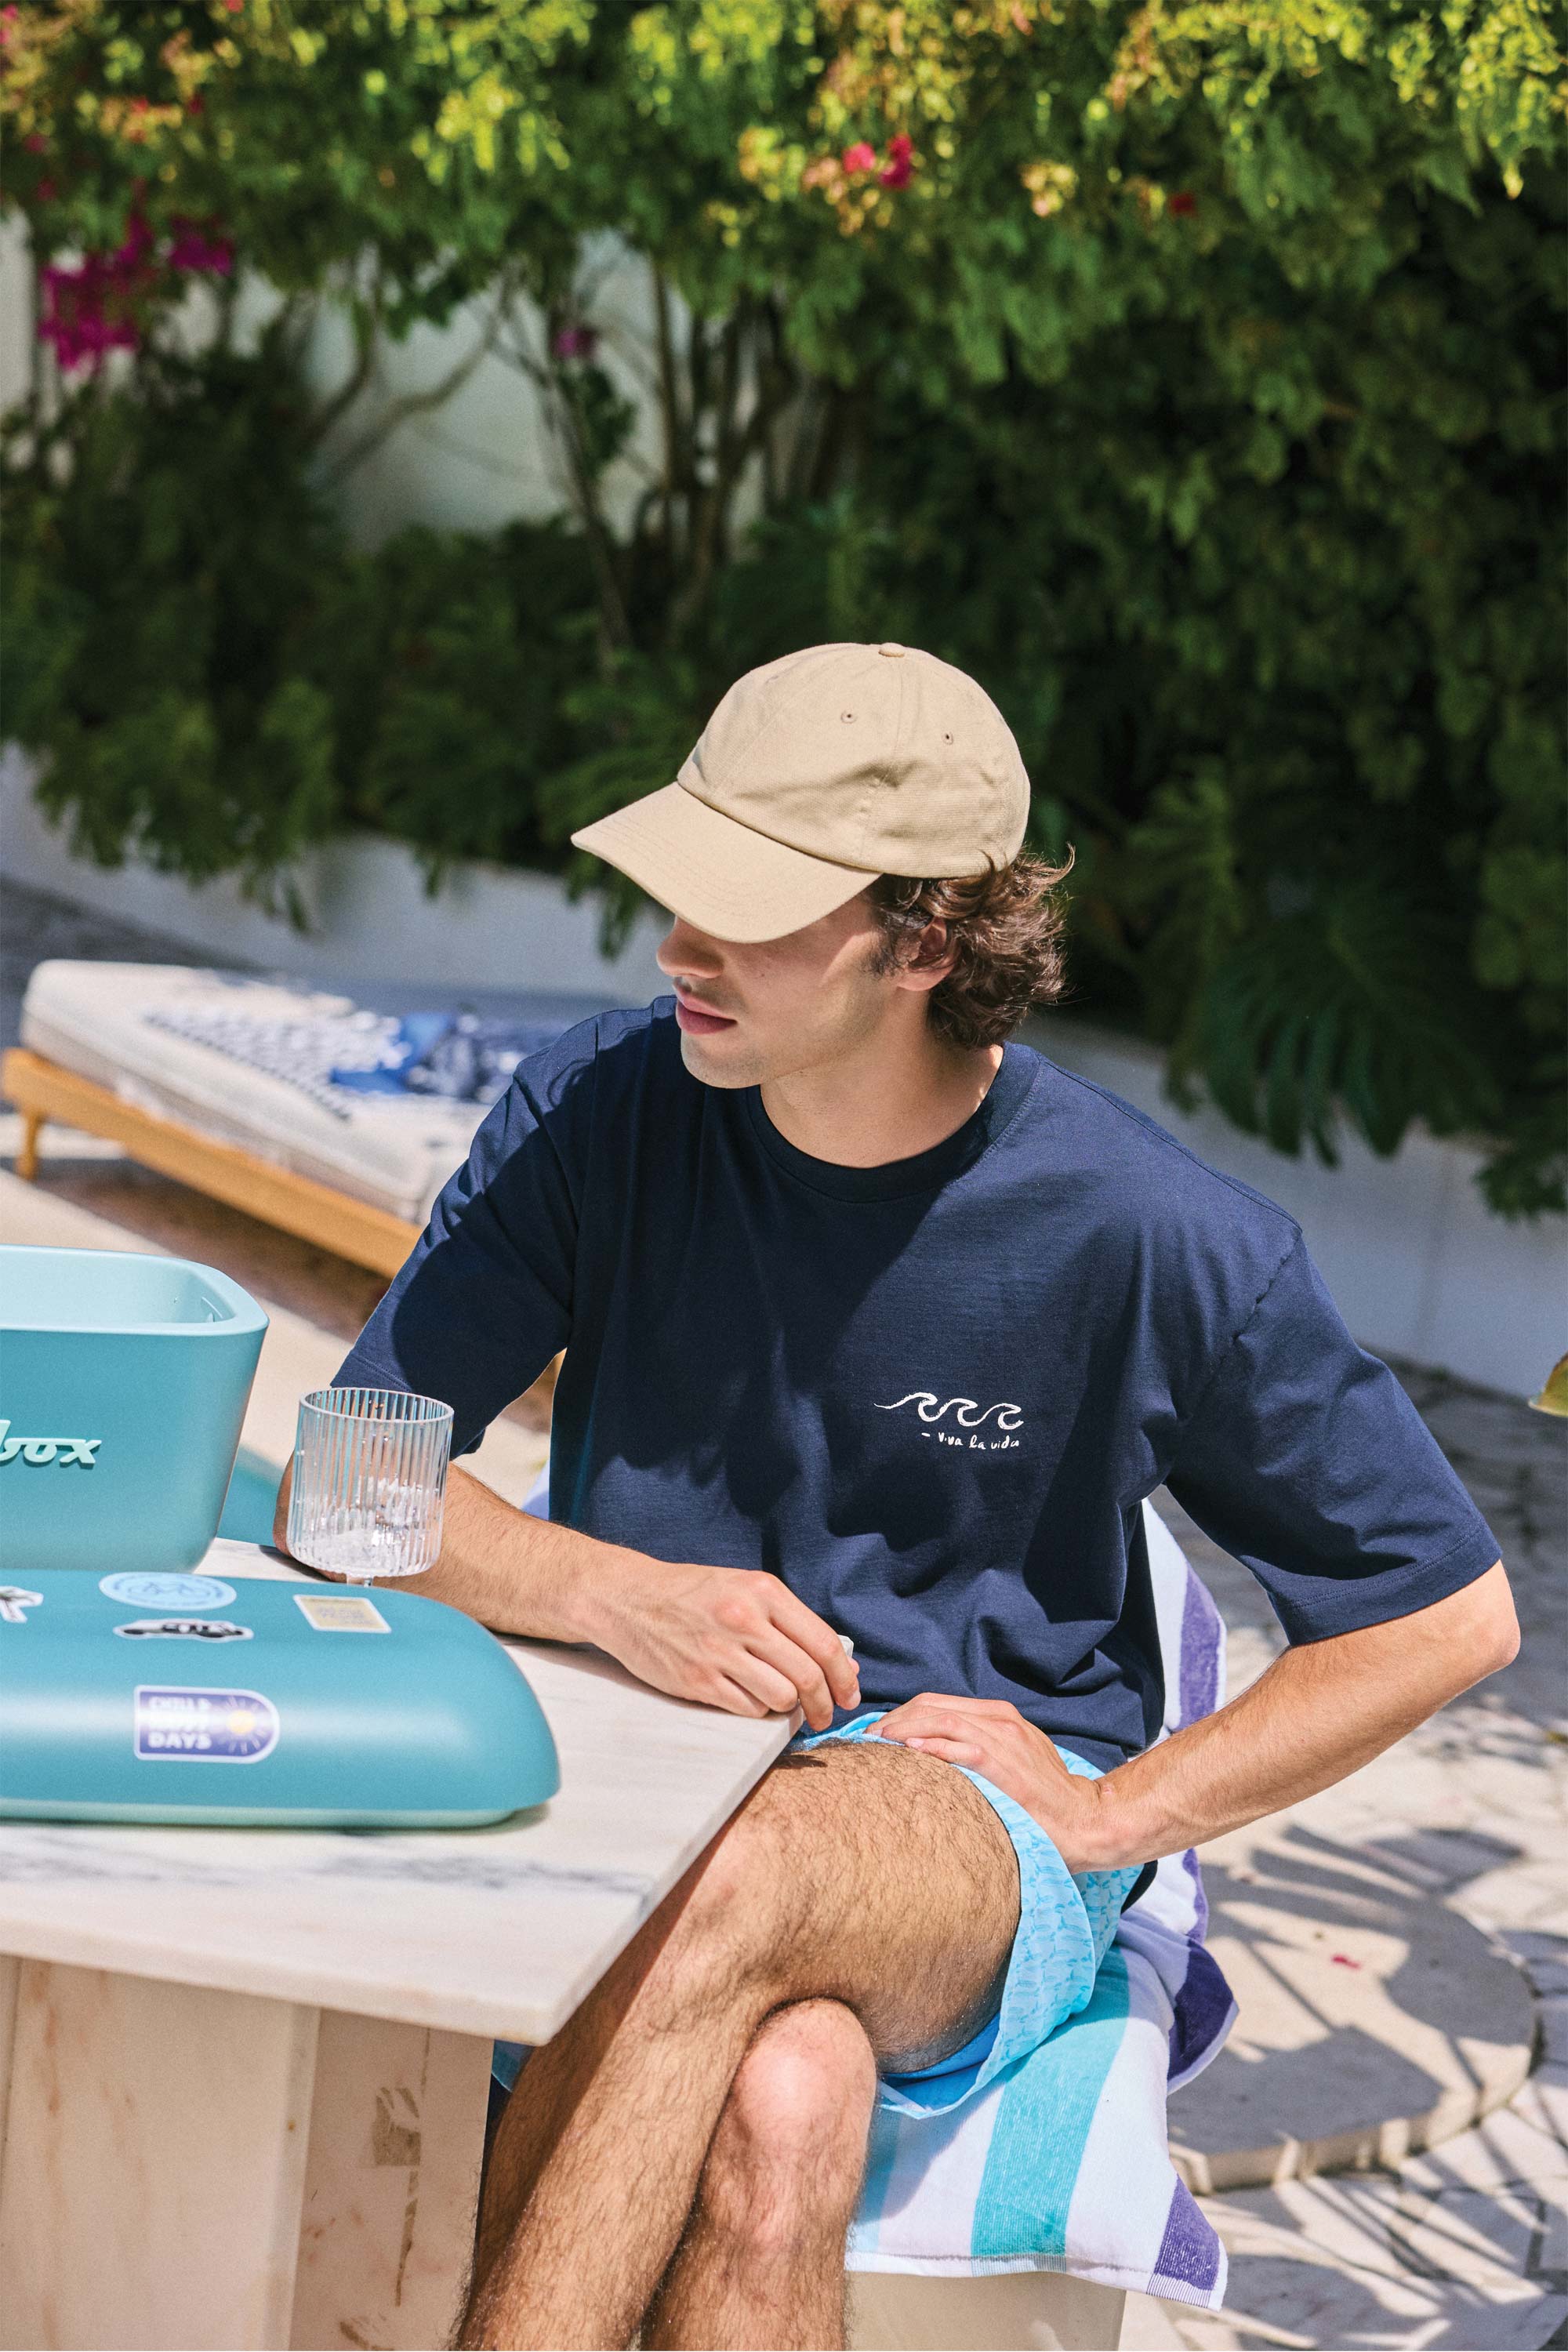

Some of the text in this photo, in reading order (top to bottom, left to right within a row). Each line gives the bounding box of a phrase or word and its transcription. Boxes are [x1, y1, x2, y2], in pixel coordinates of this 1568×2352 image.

[969, 1434, 986, 1450] la
[990, 1435, 1020, 1450] vida
[147, 1730, 212, 1750] DAYS
